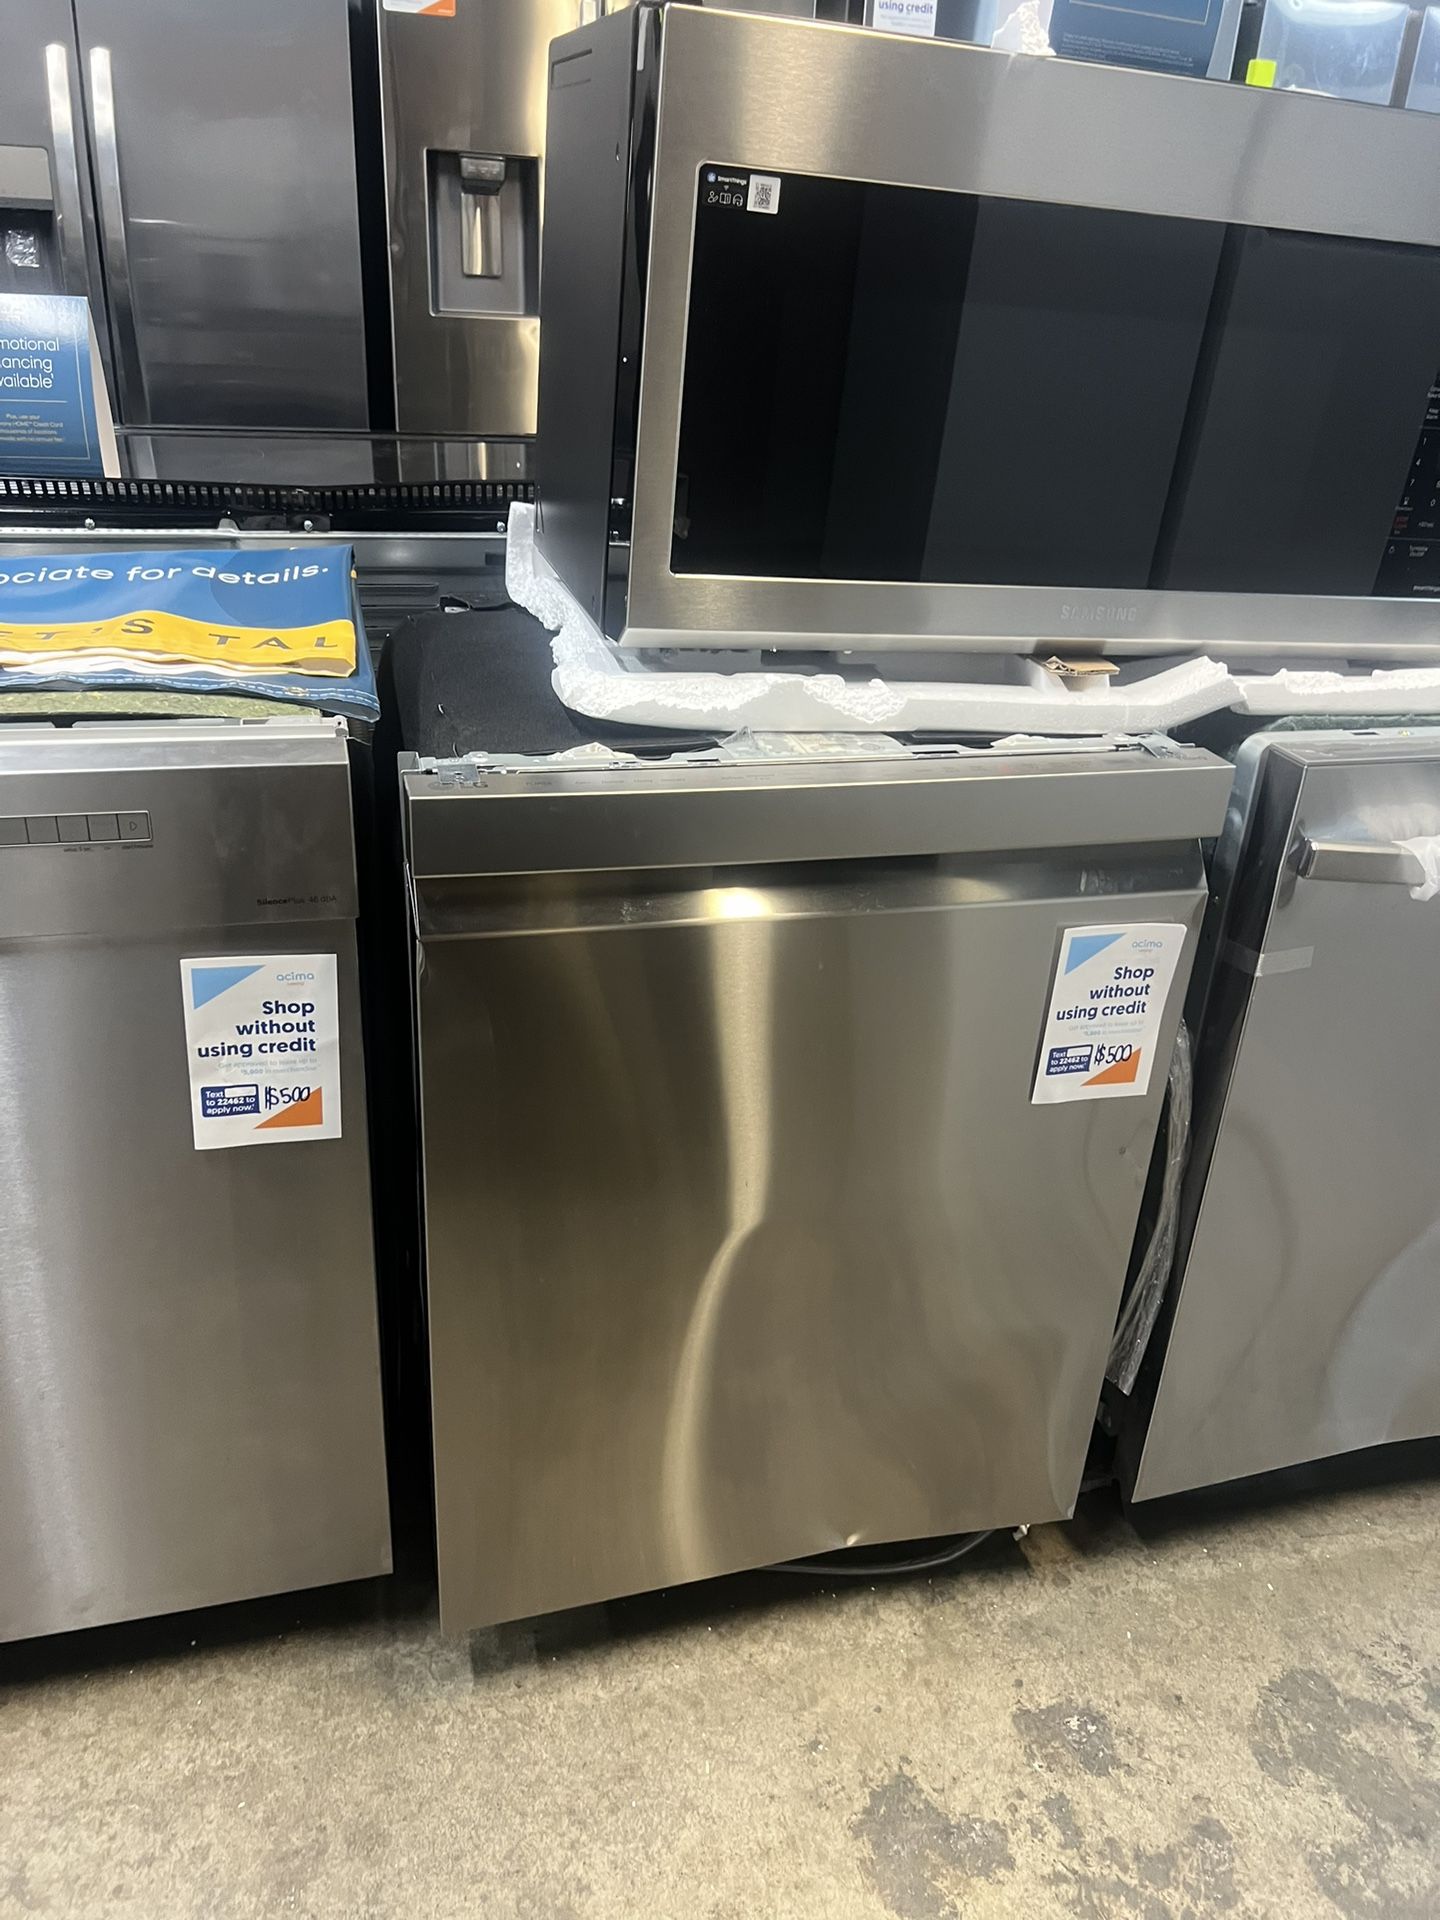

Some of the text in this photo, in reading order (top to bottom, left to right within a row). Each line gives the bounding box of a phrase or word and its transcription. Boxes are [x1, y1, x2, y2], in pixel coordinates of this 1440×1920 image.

[879, 1, 933, 14] using credit
[0, 355, 53, 373] ancing
[127, 566, 182, 581] for
[192, 564, 329, 585] details.
[1060, 604, 1136, 621] SAMSUNG
[208, 633, 338, 649] TAL
[1132, 939, 1163, 949] acima
[276, 971, 315, 981] acima
[1114, 966, 1154, 981] Shop
[1090, 983, 1150, 999] without
[262, 1000, 315, 1016] Shop
[1056, 1001, 1146, 1021] using credit
[236, 1019, 315, 1035] without
[198, 1037, 316, 1057] using credit
[1049, 1065, 1068, 1073] apply
[206, 1105, 231, 1114] apply
[217, 1097, 244, 1106] 22462
